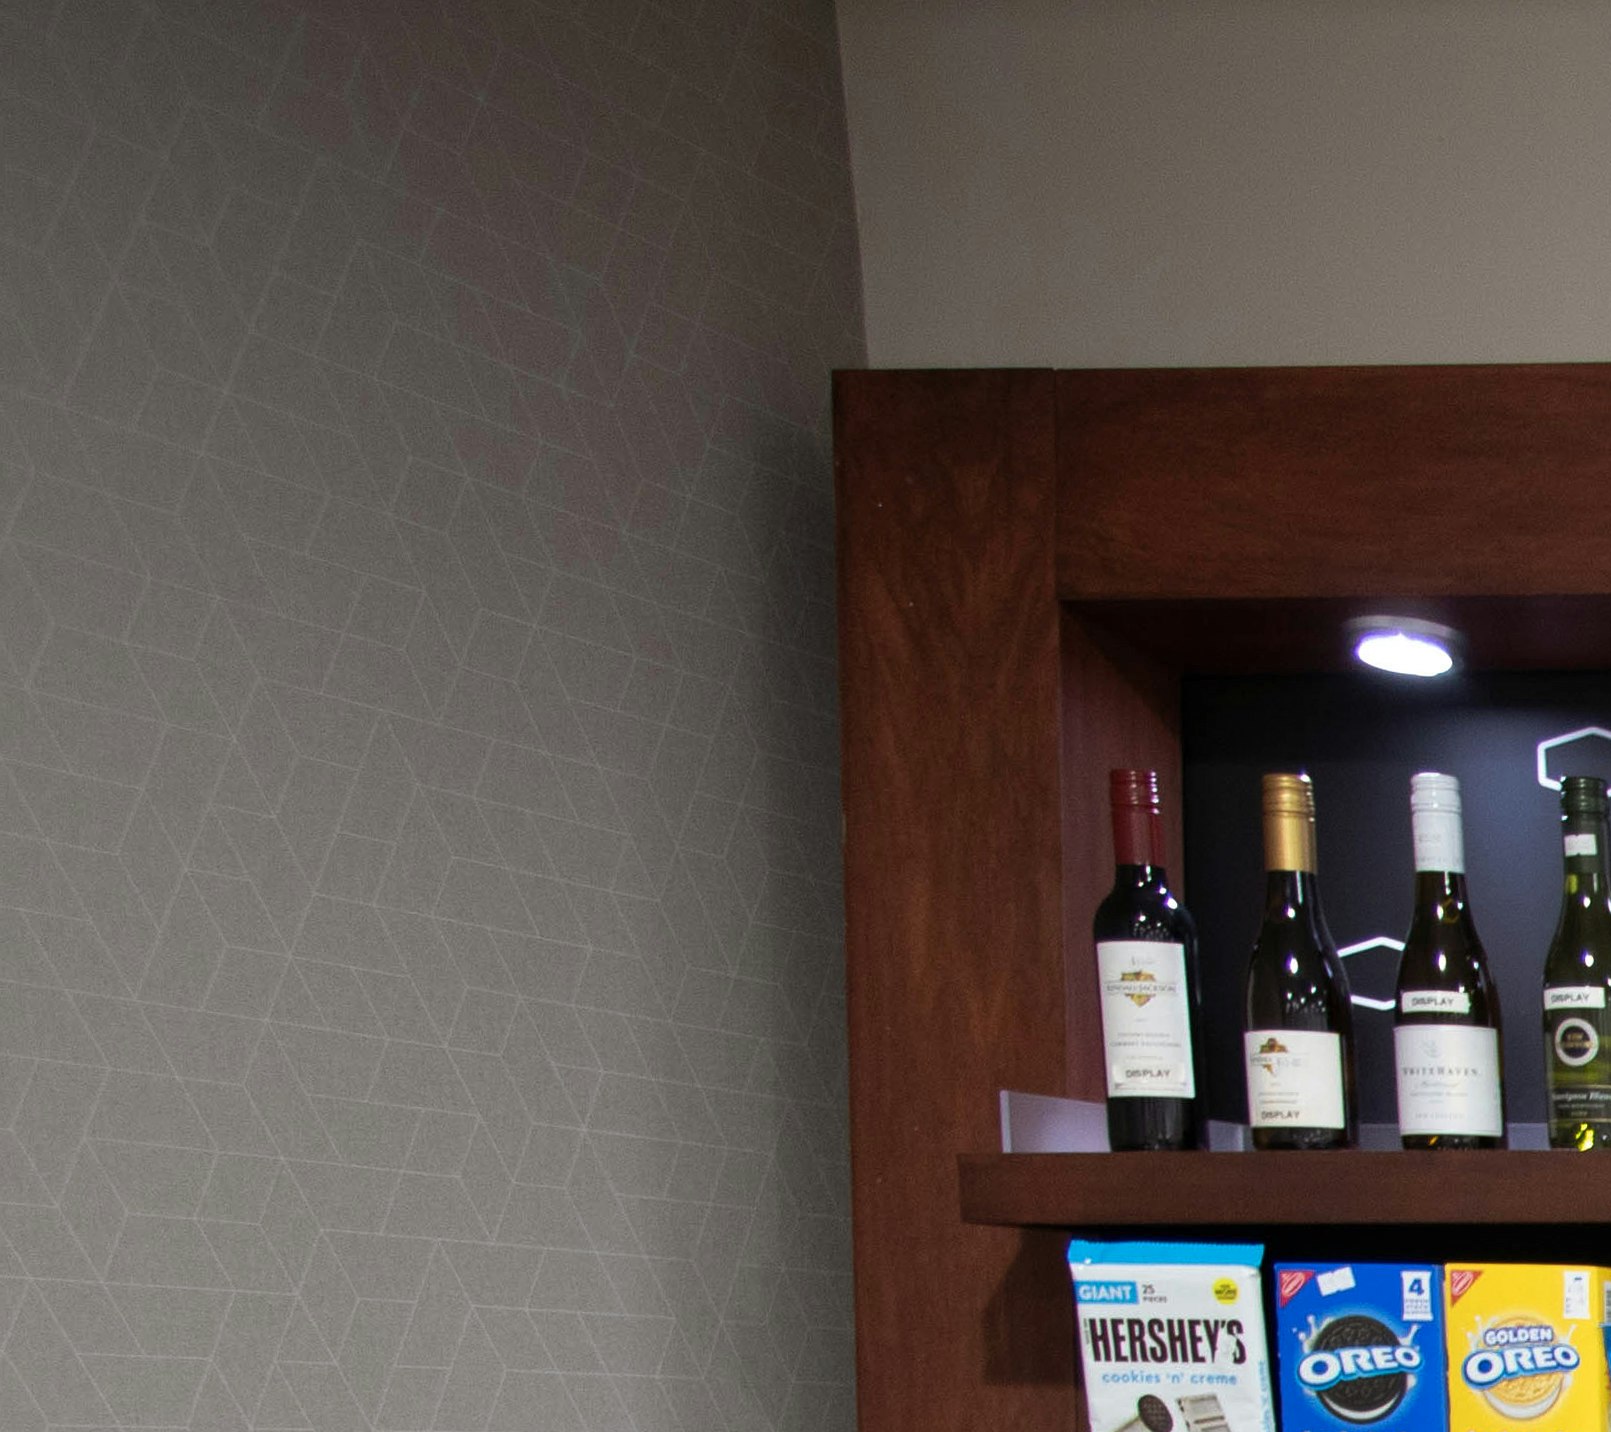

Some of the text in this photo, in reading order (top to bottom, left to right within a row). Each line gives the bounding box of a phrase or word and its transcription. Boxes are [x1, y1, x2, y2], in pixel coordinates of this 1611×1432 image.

[1411, 997, 1455, 1006] DISPLAY
[1125, 1069, 1171, 1079] DISPLAY
[1261, 1111, 1300, 1120] DISPLAY
[1079, 1285, 1132, 1300] GIANT
[1088, 1318, 1247, 1365] HERSHEY'S
[1484, 1327, 1553, 1344] GOLDEN
[1299, 1346, 1421, 1384] OREO
[1465, 1346, 1579, 1383] OREO
